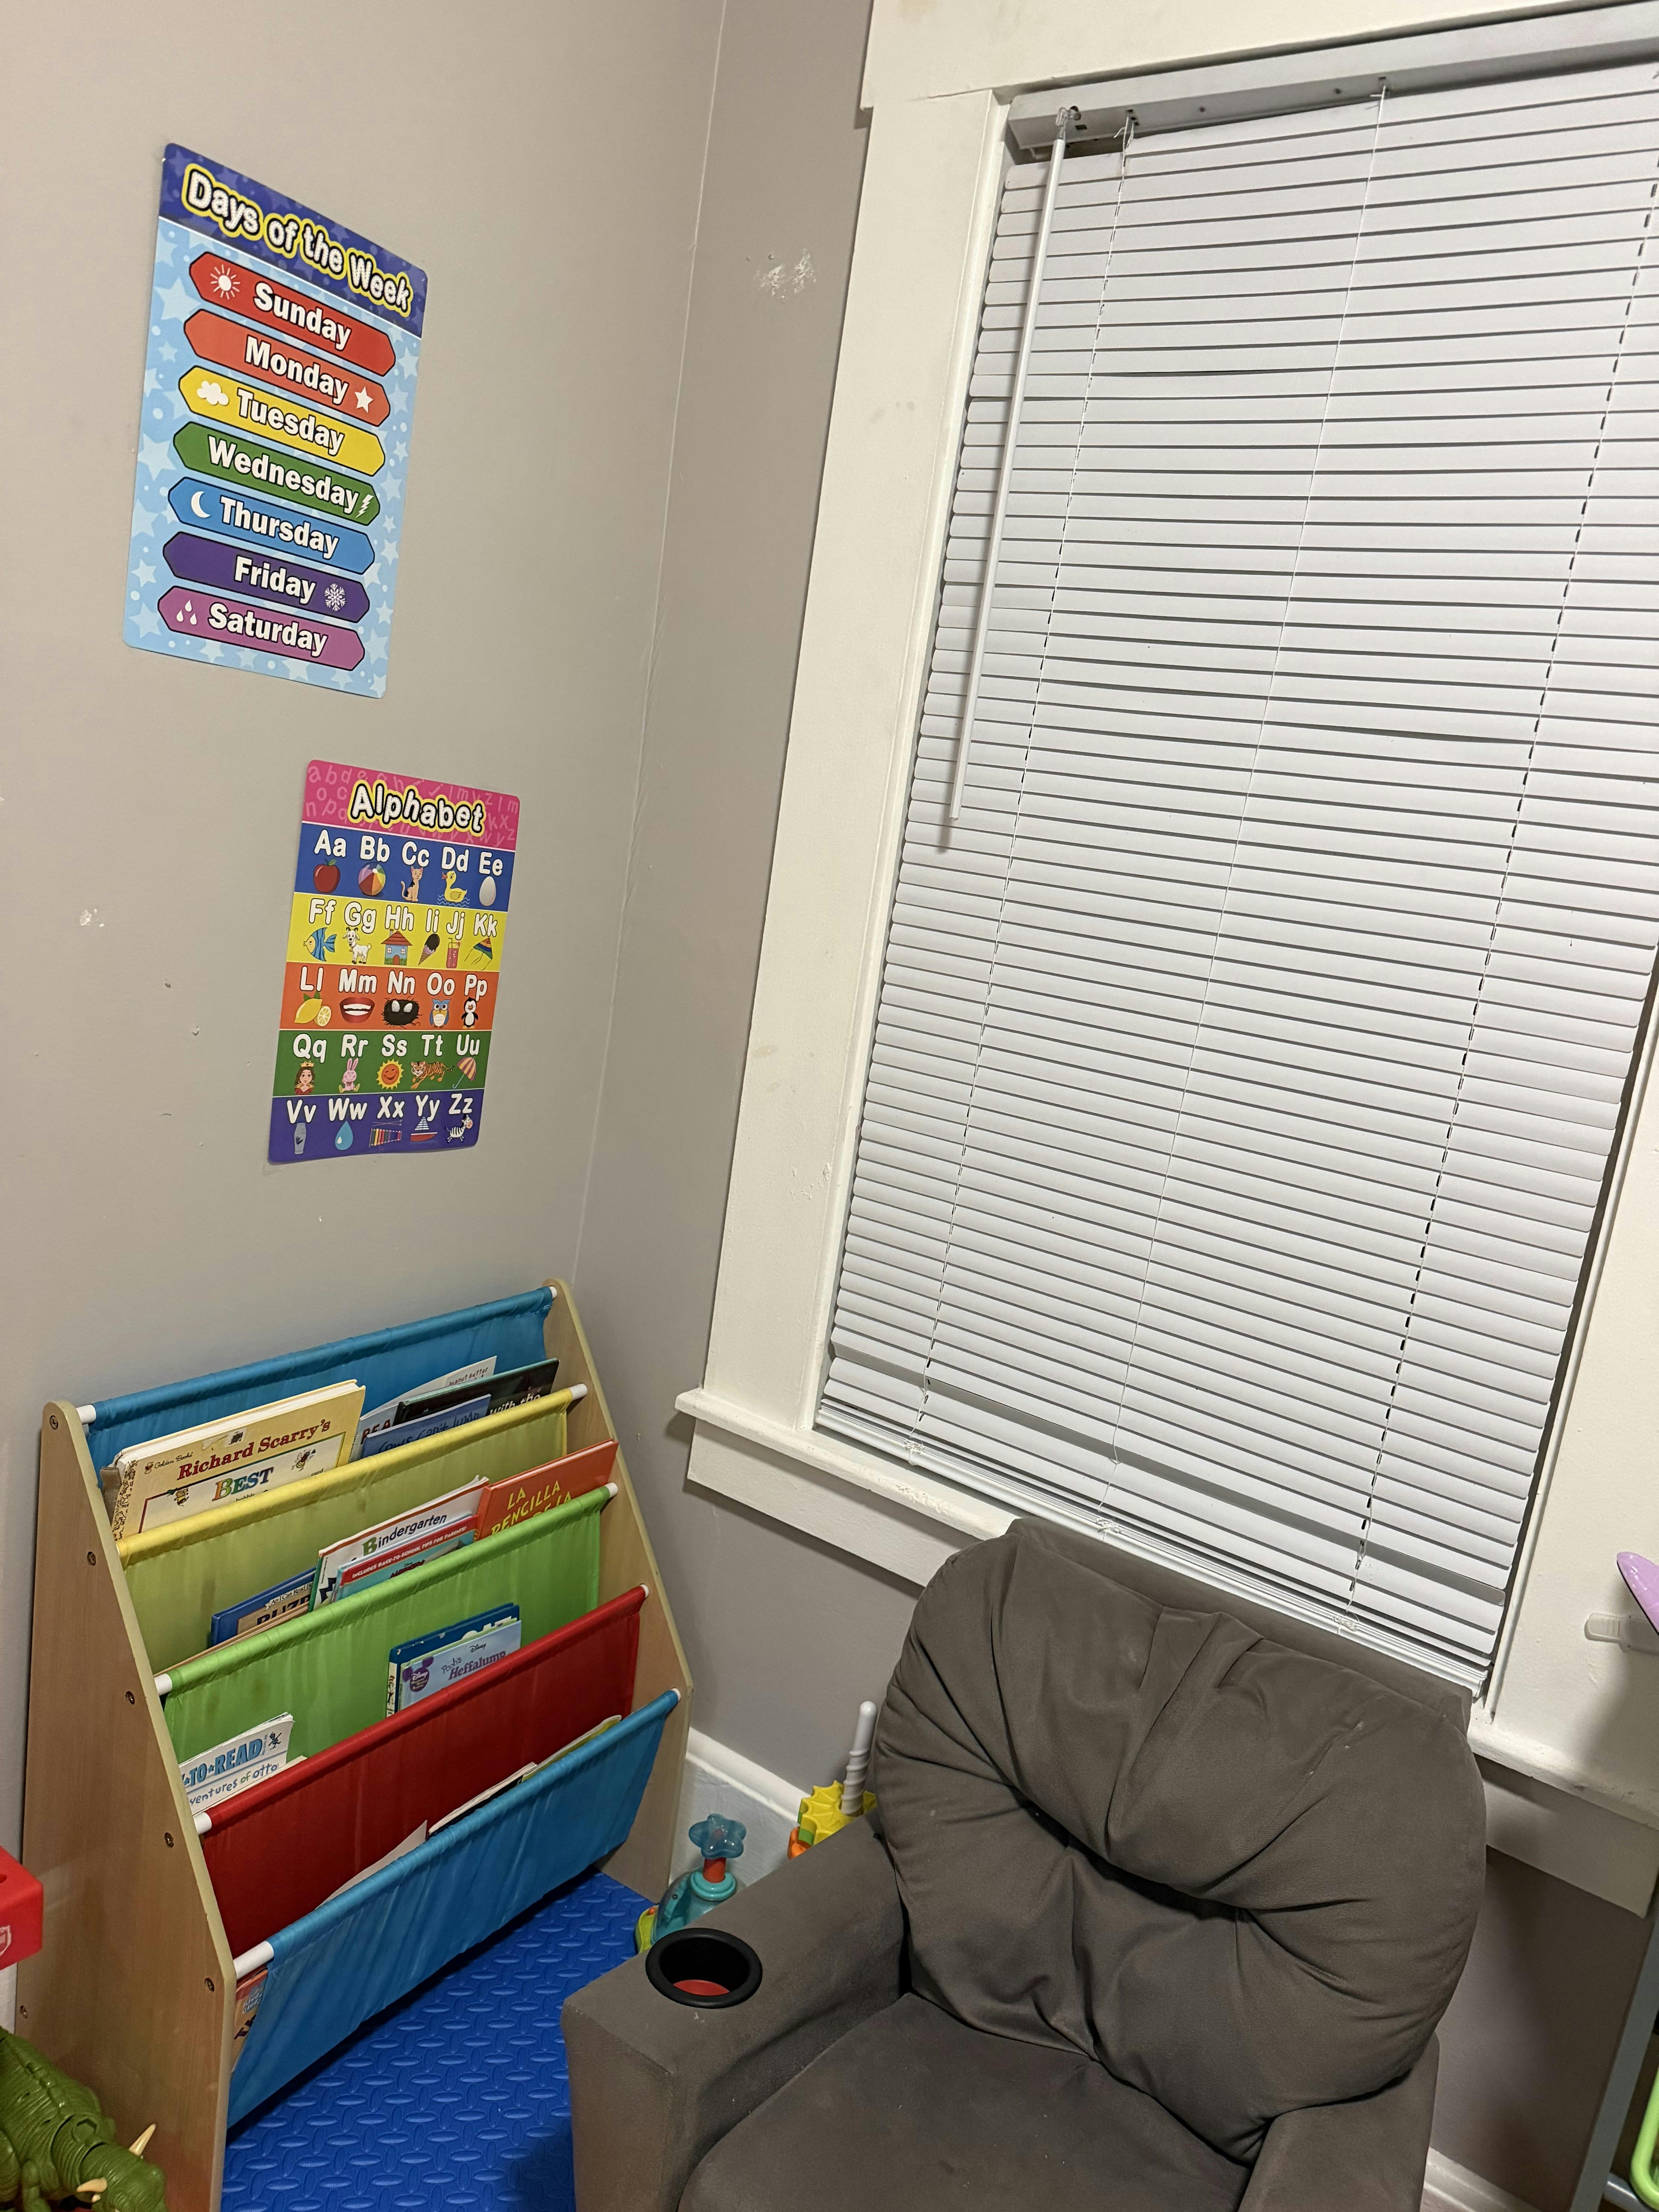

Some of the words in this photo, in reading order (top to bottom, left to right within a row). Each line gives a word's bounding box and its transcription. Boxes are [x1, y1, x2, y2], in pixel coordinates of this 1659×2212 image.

[185, 168, 261, 235] Days
[266, 216, 299, 254] of
[302, 225, 344, 273] the
[350, 252, 411, 312] Week
[253, 281, 351, 351] Sunday
[244, 335, 349, 405] Monday
[237, 389, 345, 456] Tuesday
[208, 435, 359, 514] Wednesday
[220, 496, 339, 559] Thursday
[234, 556, 316, 604] Friday
[208, 602, 328, 656] Saturday
[350, 783, 484, 833] Alphabet
[314, 829, 347, 857] Aa
[360, 835, 390, 862] Bb
[402, 841, 430, 867] Cc
[441, 846, 469, 872] Dd
[479, 851, 503, 876] Ee
[309, 898, 337, 925] Ff
[344, 901, 377, 934] Gg
[385, 905, 414, 931] Hh
[425, 908, 440, 933] Ii
[446, 911, 465, 940] Jj
[473, 912, 498, 937] Kk
[299, 965, 324, 993] Ll
[338, 968, 377, 994] Mm
[388, 970, 416, 995] Nn
[427, 972, 455, 996] Oo
[464, 974, 488, 1002] Pp
[293, 1033, 327, 1063] Qq
[341, 1034, 368, 1057] Rr
[381, 1034, 407, 1057] Ss
[421, 1034, 443, 1056] Tt
[456, 1034, 480, 1056] Uu
[287, 1099, 316, 1123] Vv
[328, 1097, 368, 1121] Ww
[377, 1096, 405, 1119] Xx
[416, 1095, 440, 1121] Yy
[448, 1093, 473, 1115] Zz
[155, 1460, 174, 1469] Golden
[176, 1441, 254, 1480] Richard
[258, 1419, 331, 1453] Scarry's
[212, 1467, 274, 1501] BEST
[507, 1487, 526, 1510] LA
[352, 1566, 378, 1578] INCLUDES
[378, 1546, 421, 1568] BACK-TO-SCHOOL
[422, 1540, 433, 1549] TIPS
[433, 1535, 443, 1545] FOR
[444, 1526, 467, 1541] PARENTS!
[362, 1514, 447, 1556] Bindergarten
[293, 1586, 306, 1595] Read
[441, 1657, 462, 1674] Pooh's
[448, 1650, 506, 1680] Heffalump
[470, 1642, 487, 1653] Disney
[189, 1763, 208, 1786] TO
[214, 1738, 263, 1776] READ
[240, 1771, 251, 1784] of
